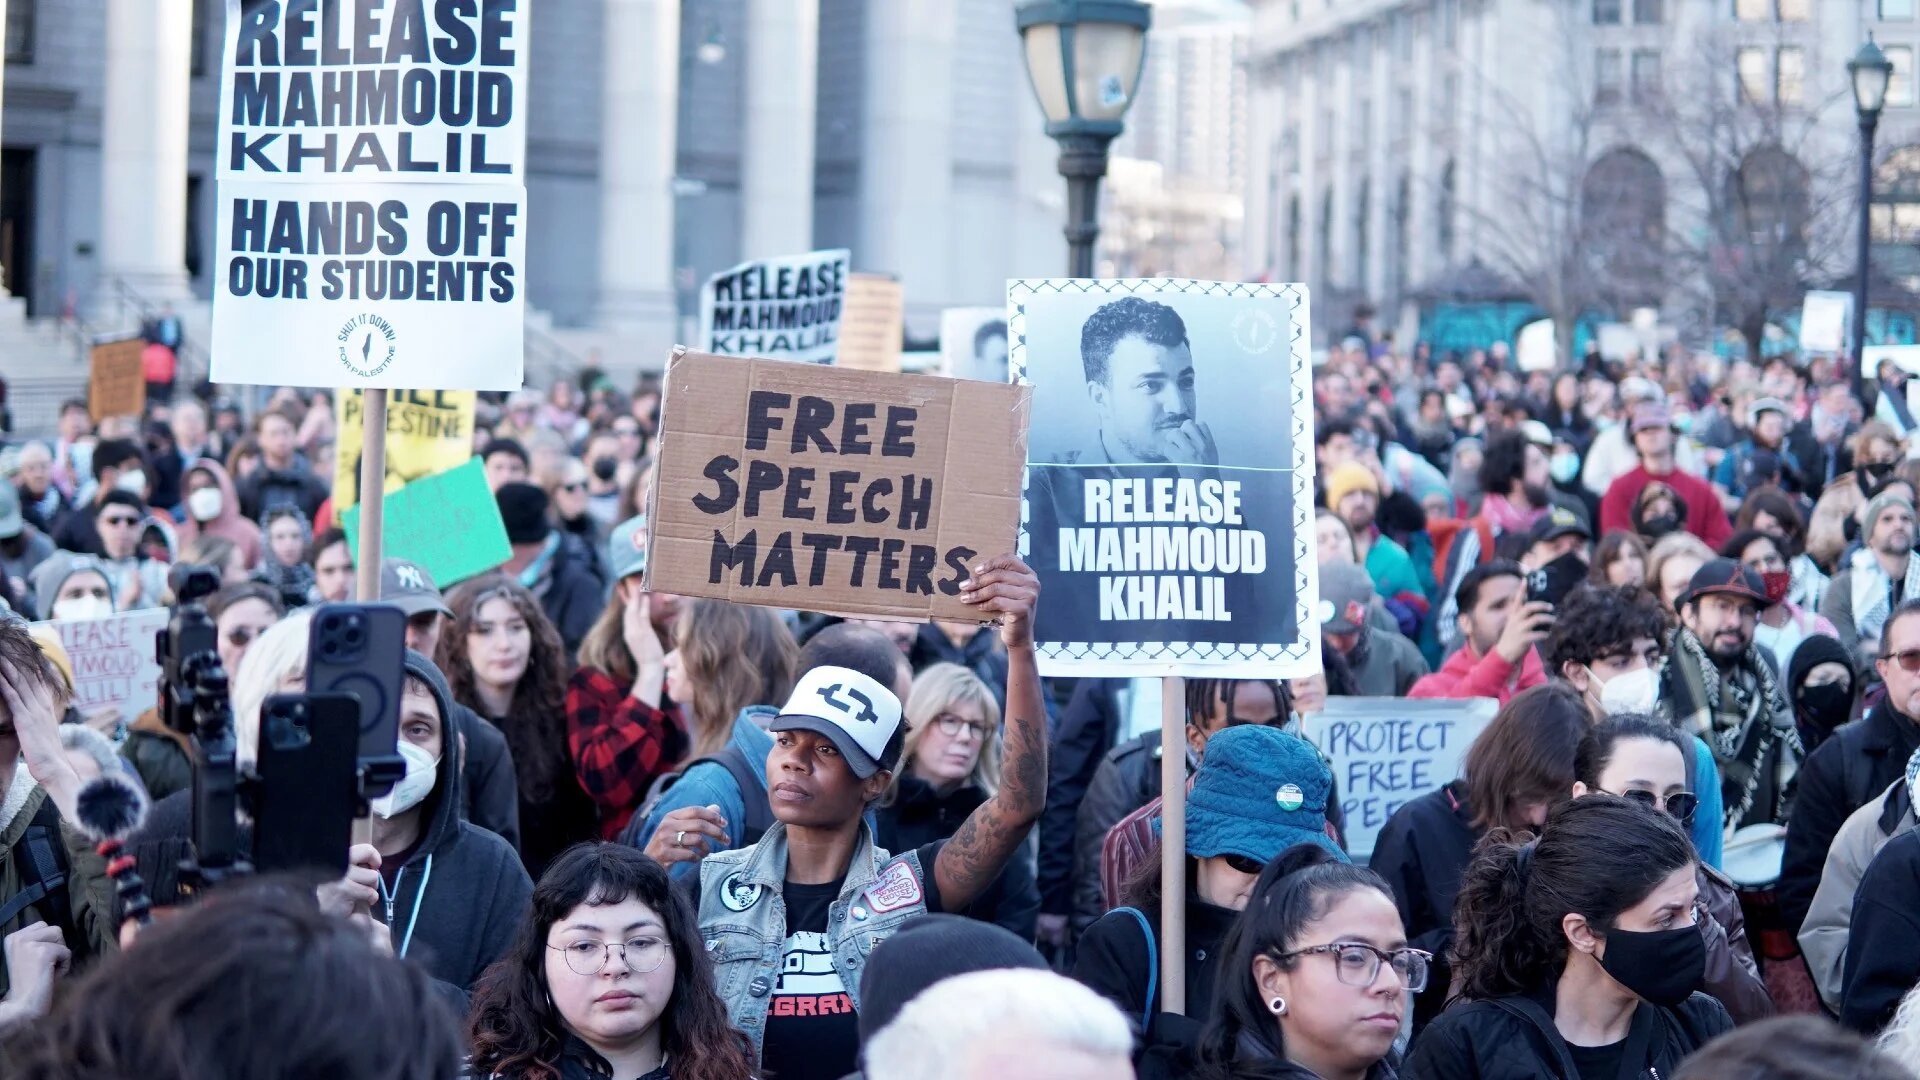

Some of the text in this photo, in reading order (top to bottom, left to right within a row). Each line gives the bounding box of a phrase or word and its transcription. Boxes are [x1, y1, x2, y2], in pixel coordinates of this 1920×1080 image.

[235, 0, 517, 66] RELEASE
[232, 68, 513, 127] MAHMOUD
[230, 131, 513, 173] KHALIL
[231, 198, 518, 257] HANDS OFF
[228, 256, 515, 303] OUR STUDENTS
[715, 259, 844, 302] RELEASE
[338, 313, 396, 342] SHUT IT DOWN!
[712, 299, 841, 331] MAHMOUD
[339, 345, 396, 378] FOR PALESTINE
[711, 327, 836, 354] KHALIL
[344, 399, 464, 439] PESTINE
[745, 390, 918, 458] FREE
[691, 454, 933, 531] SPEECH
[1084, 477, 1243, 525] RELEASE
[709, 528, 978, 597] MATTERS
[1059, 526, 1267, 574] MAHMOUD
[1100, 575, 1232, 622] KHALIL
[1329, 720, 1456, 756] PROTECT
[1348, 758, 1434, 793] FREE
[879, 880, 912, 897] WHORE
[882, 888, 913, 903] HOUSE
